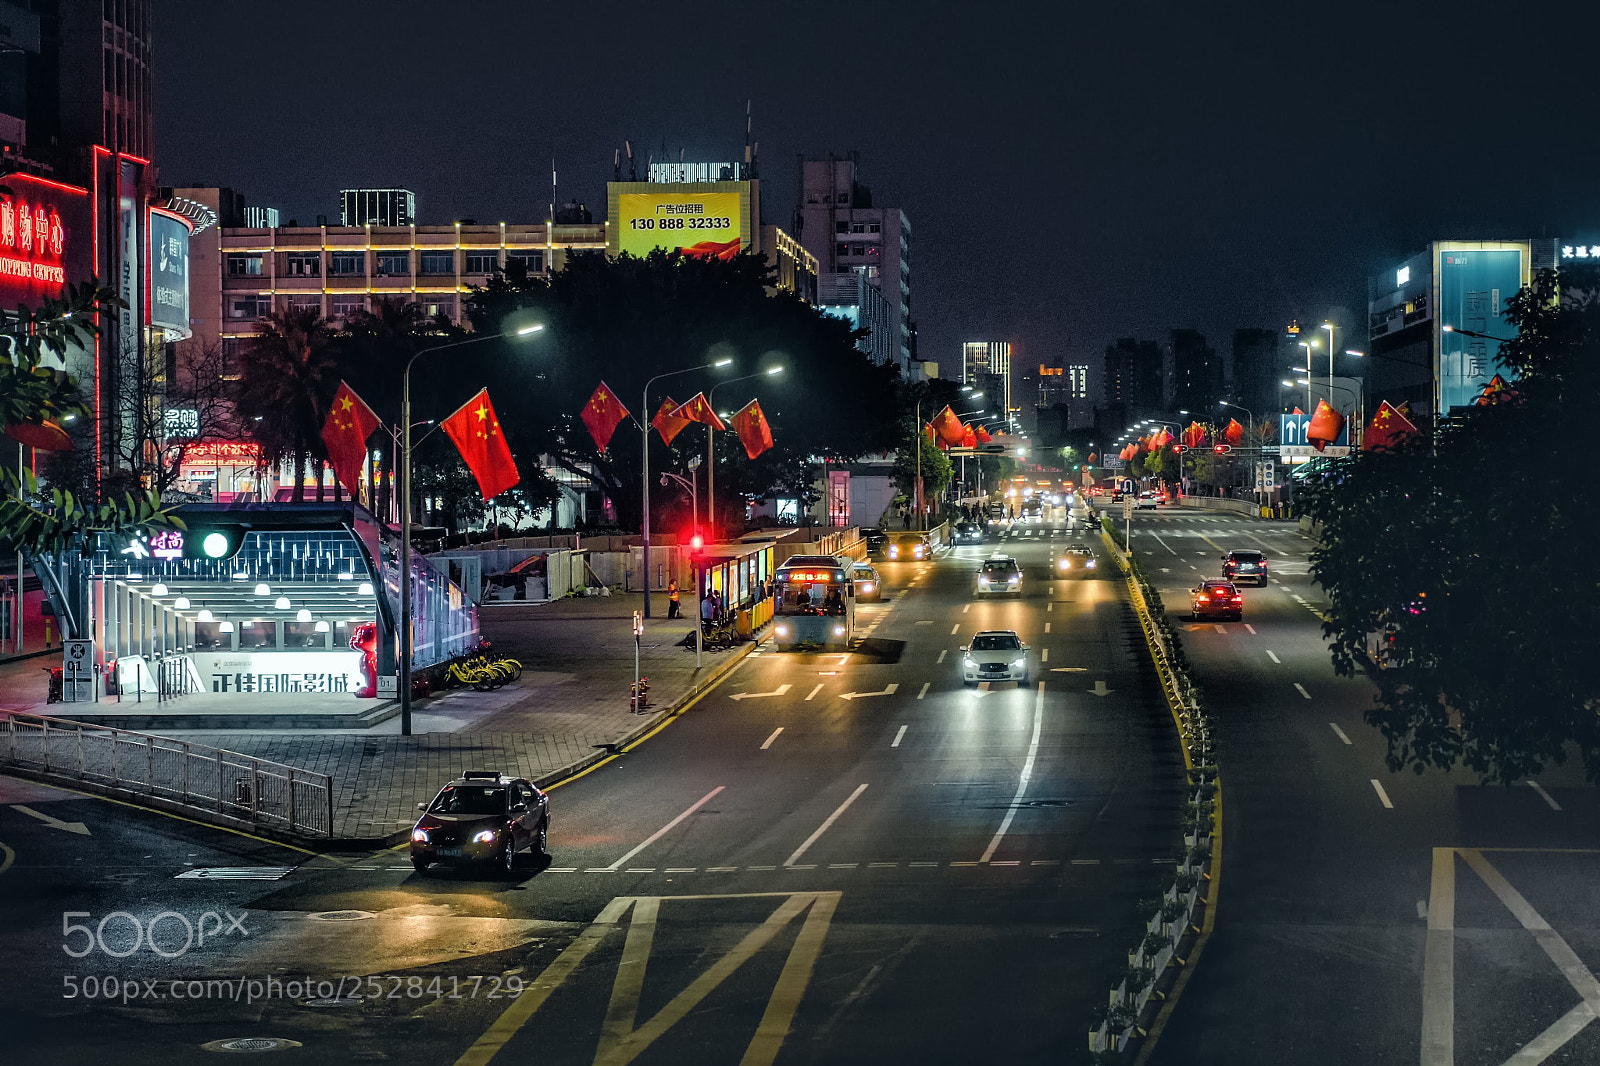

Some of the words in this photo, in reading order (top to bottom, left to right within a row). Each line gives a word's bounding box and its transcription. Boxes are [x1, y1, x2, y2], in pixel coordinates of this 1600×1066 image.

[656, 203, 704, 215] 广告位招租
[630, 218, 655, 230] 130
[659, 218, 685, 230] 888
[688, 217, 731, 229] 32333
[33, 263, 64, 283] CENTER
[67, 661, 82, 671] 01
[212, 673, 349, 692] 正佳国际影城
